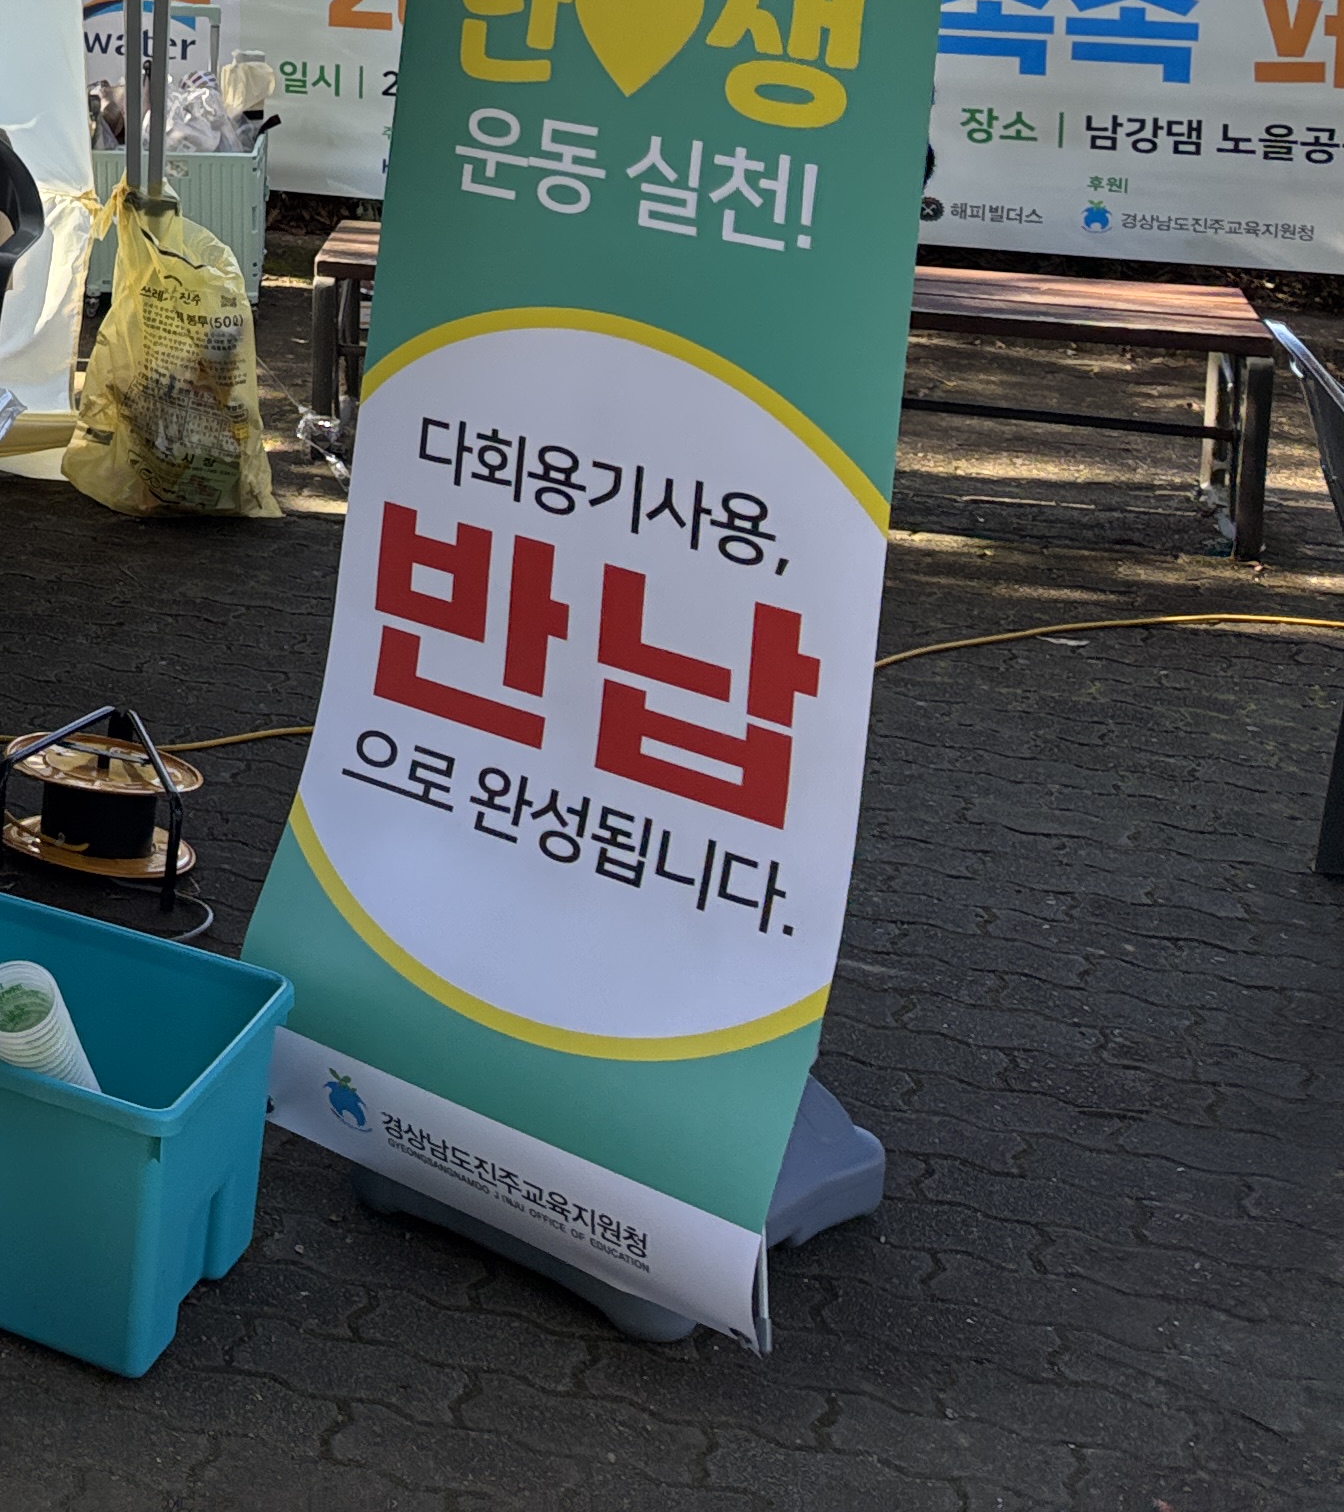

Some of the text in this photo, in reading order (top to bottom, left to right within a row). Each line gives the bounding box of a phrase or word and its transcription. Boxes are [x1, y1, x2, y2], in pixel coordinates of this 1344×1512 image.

[279, 60, 341, 98] 일시
[960, 106, 1039, 145] 장소
[1084, 114, 1204, 157] 남강댐
[1215, 122, 1344, 165] 노을공
[454, 107, 818, 253] 운동 실천!
[1120, 212, 1316, 243] 경상남도진주교육지원청
[417, 415, 791, 578] 다회용기사용,
[373, 500, 821, 831] 반납
[341, 729, 796, 938] 으로 완성됩니다.
[380, 1110, 648, 1259] 경상남도진주교육지원청
[528, 1208, 567, 1234] OFFICE
[589, 1237, 651, 1274] EDUCATION
